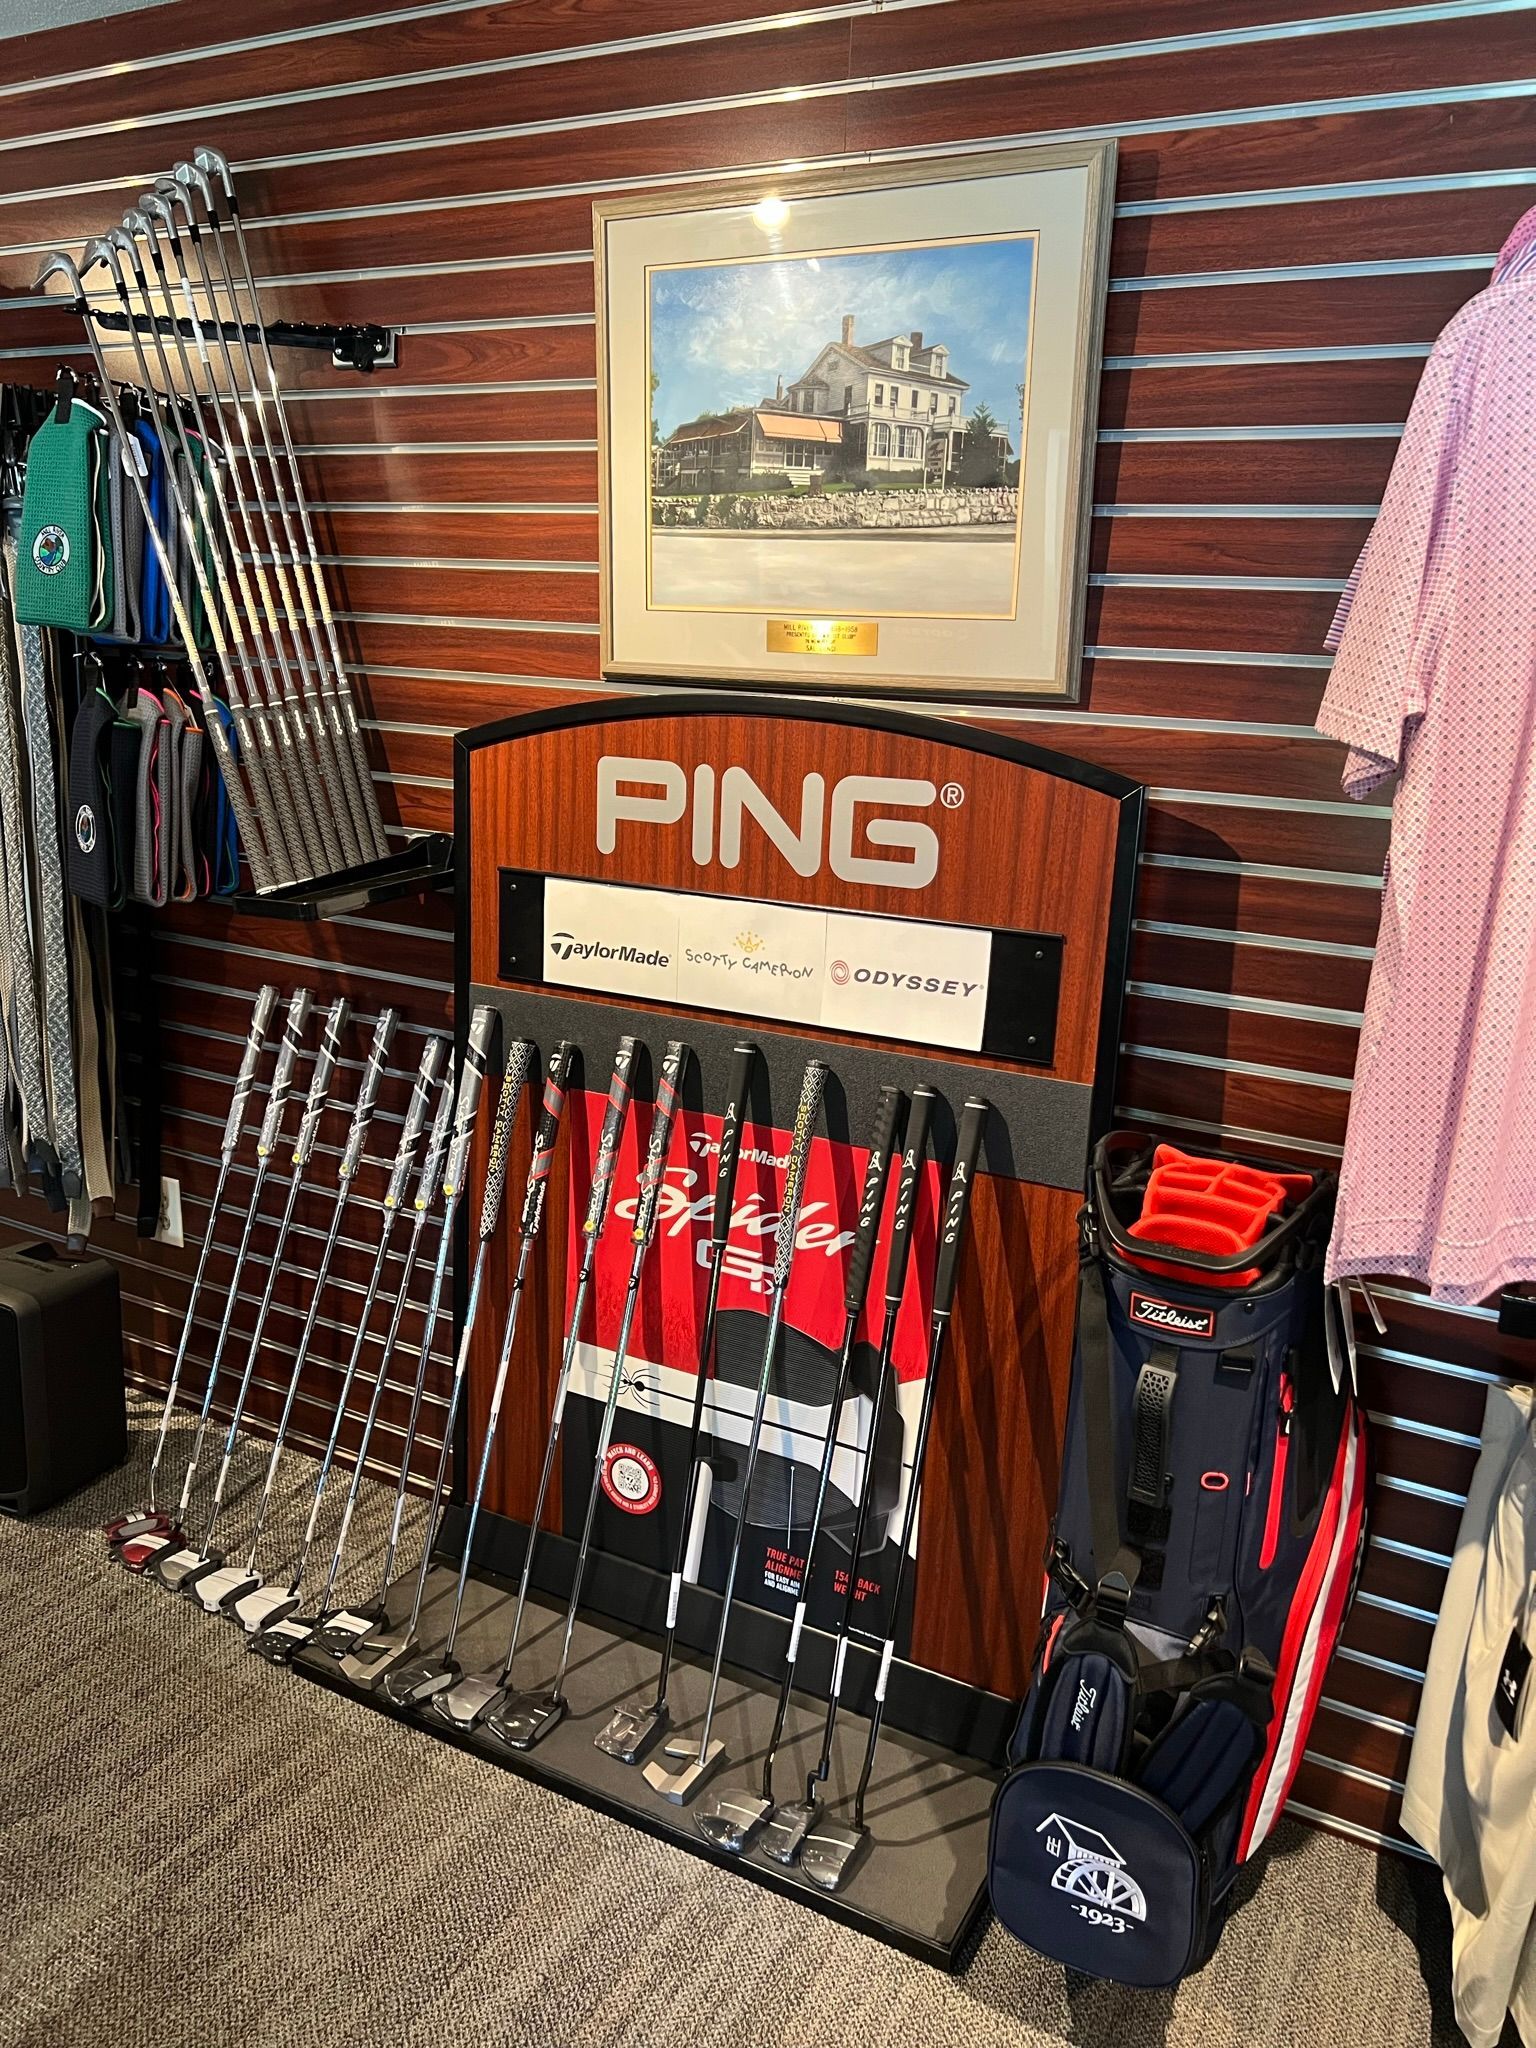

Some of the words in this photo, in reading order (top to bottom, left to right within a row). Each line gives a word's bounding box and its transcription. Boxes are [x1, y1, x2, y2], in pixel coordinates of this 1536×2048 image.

[550, 932, 670, 968] TaylorMade
[685, 948, 738, 971] SCOTTY
[742, 957, 814, 979] CAMERON
[853, 968, 979, 998] ODYSSEY
[794, 1105, 807, 1151] SCOTTY
[690, 1132, 791, 1169] TaorMad
[719, 1129, 734, 1178] PING
[783, 1155, 798, 1214] CAMERON
[614, 1167, 880, 1257] Spider
[860, 1177, 879, 1227] PING
[895, 1177, 913, 1230] PING
[944, 1190, 963, 1244] PING
[1135, 1301, 1209, 1331] Titleist
[624, 1446, 637, 1456] AND
[765, 1559, 813, 1581] ALIGNME
[766, 1547, 788, 1563] TRUE
[764, 1570, 776, 1580] FOR
[776, 1573, 790, 1585] EASY
[764, 1578, 775, 1588] AND
[775, 1582, 800, 1597] ALIGNME
[833, 1582, 868, 1603] WEHT
[857, 1578, 881, 1596] BACK
[1071, 1679, 1097, 1732] Titleist
